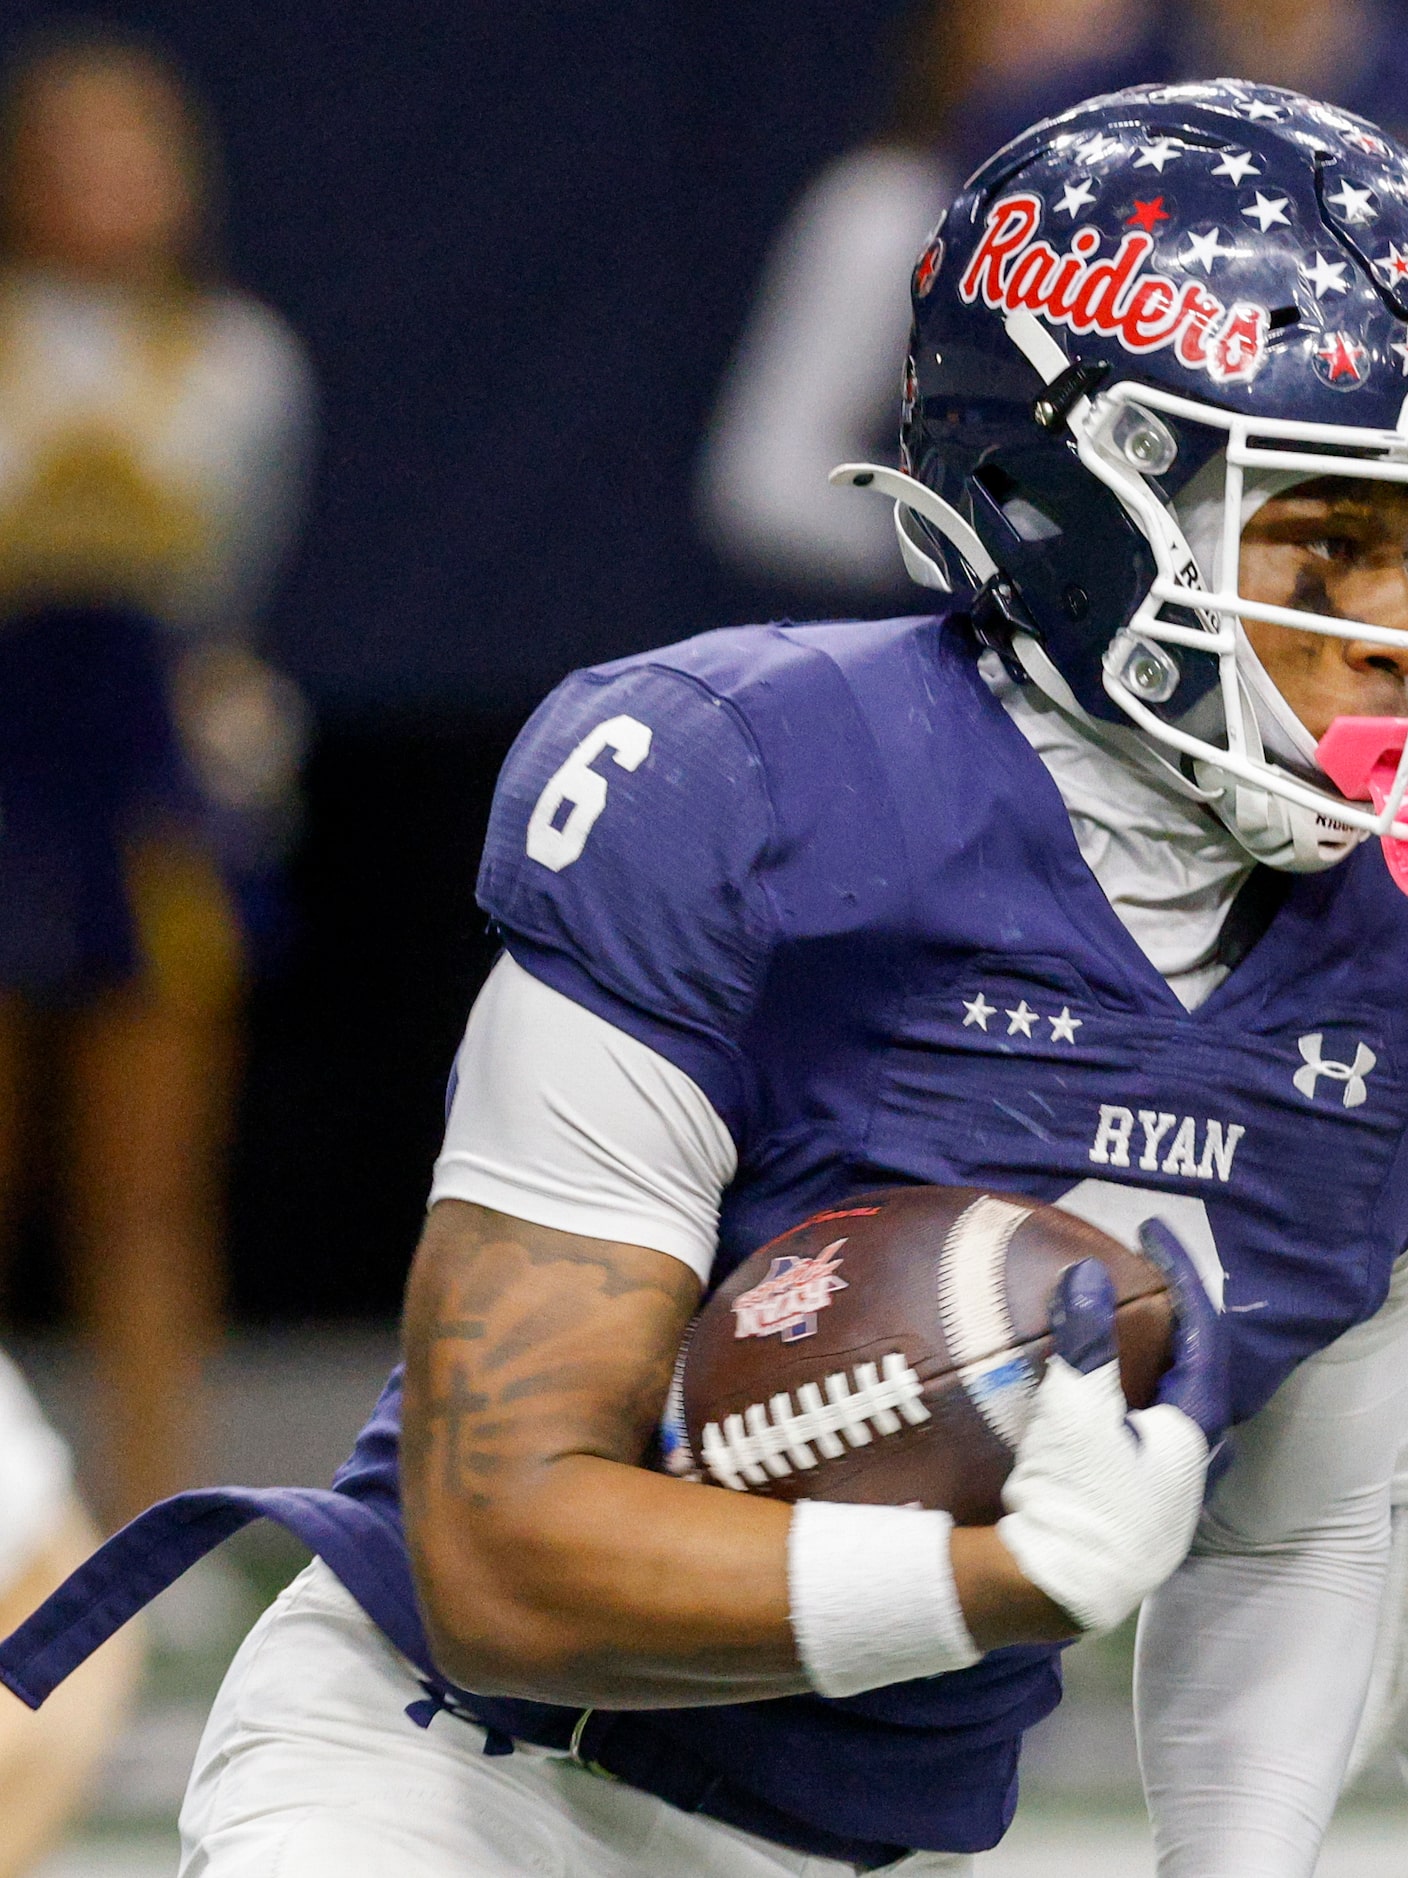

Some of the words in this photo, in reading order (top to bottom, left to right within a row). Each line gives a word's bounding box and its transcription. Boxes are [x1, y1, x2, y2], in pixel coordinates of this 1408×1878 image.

[959, 193, 1269, 384] Raiders
[526, 713, 653, 873] 6
[1088, 1103, 1246, 1183] RYAN
